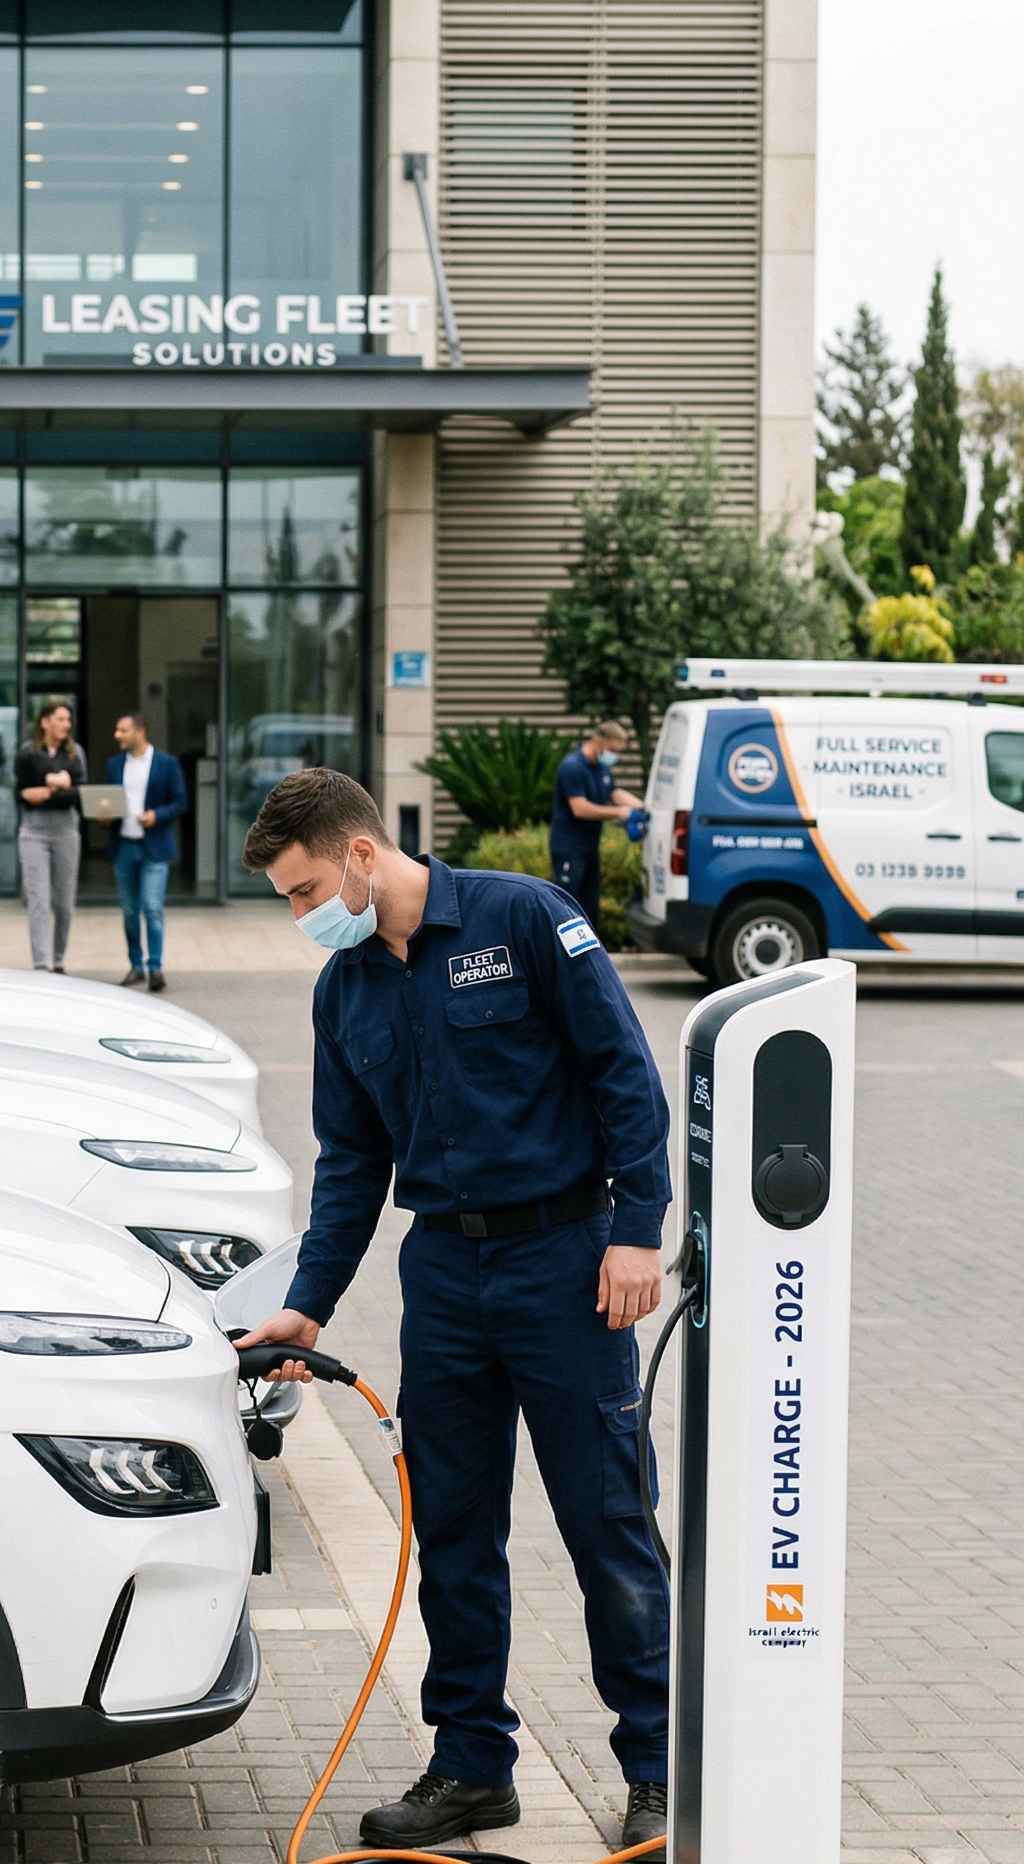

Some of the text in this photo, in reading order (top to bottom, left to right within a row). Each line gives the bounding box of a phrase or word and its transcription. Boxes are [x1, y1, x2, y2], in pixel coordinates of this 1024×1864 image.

[41, 293, 429, 335] LEASING FLEET
[132, 341, 337, 367] SOLUTIONS
[816, 737, 942, 753] FULL SERVICE
[813, 760, 947, 776] MAINTENANCE
[849, 783, 912, 799] ISRAEL
[463, 952, 495, 970] FLEET
[453, 963, 509, 985] OPERATOR
[774, 1260, 805, 1343] 2026
[772, 1378, 802, 1518] CHARGE
[771, 1527, 799, 1569] EV
